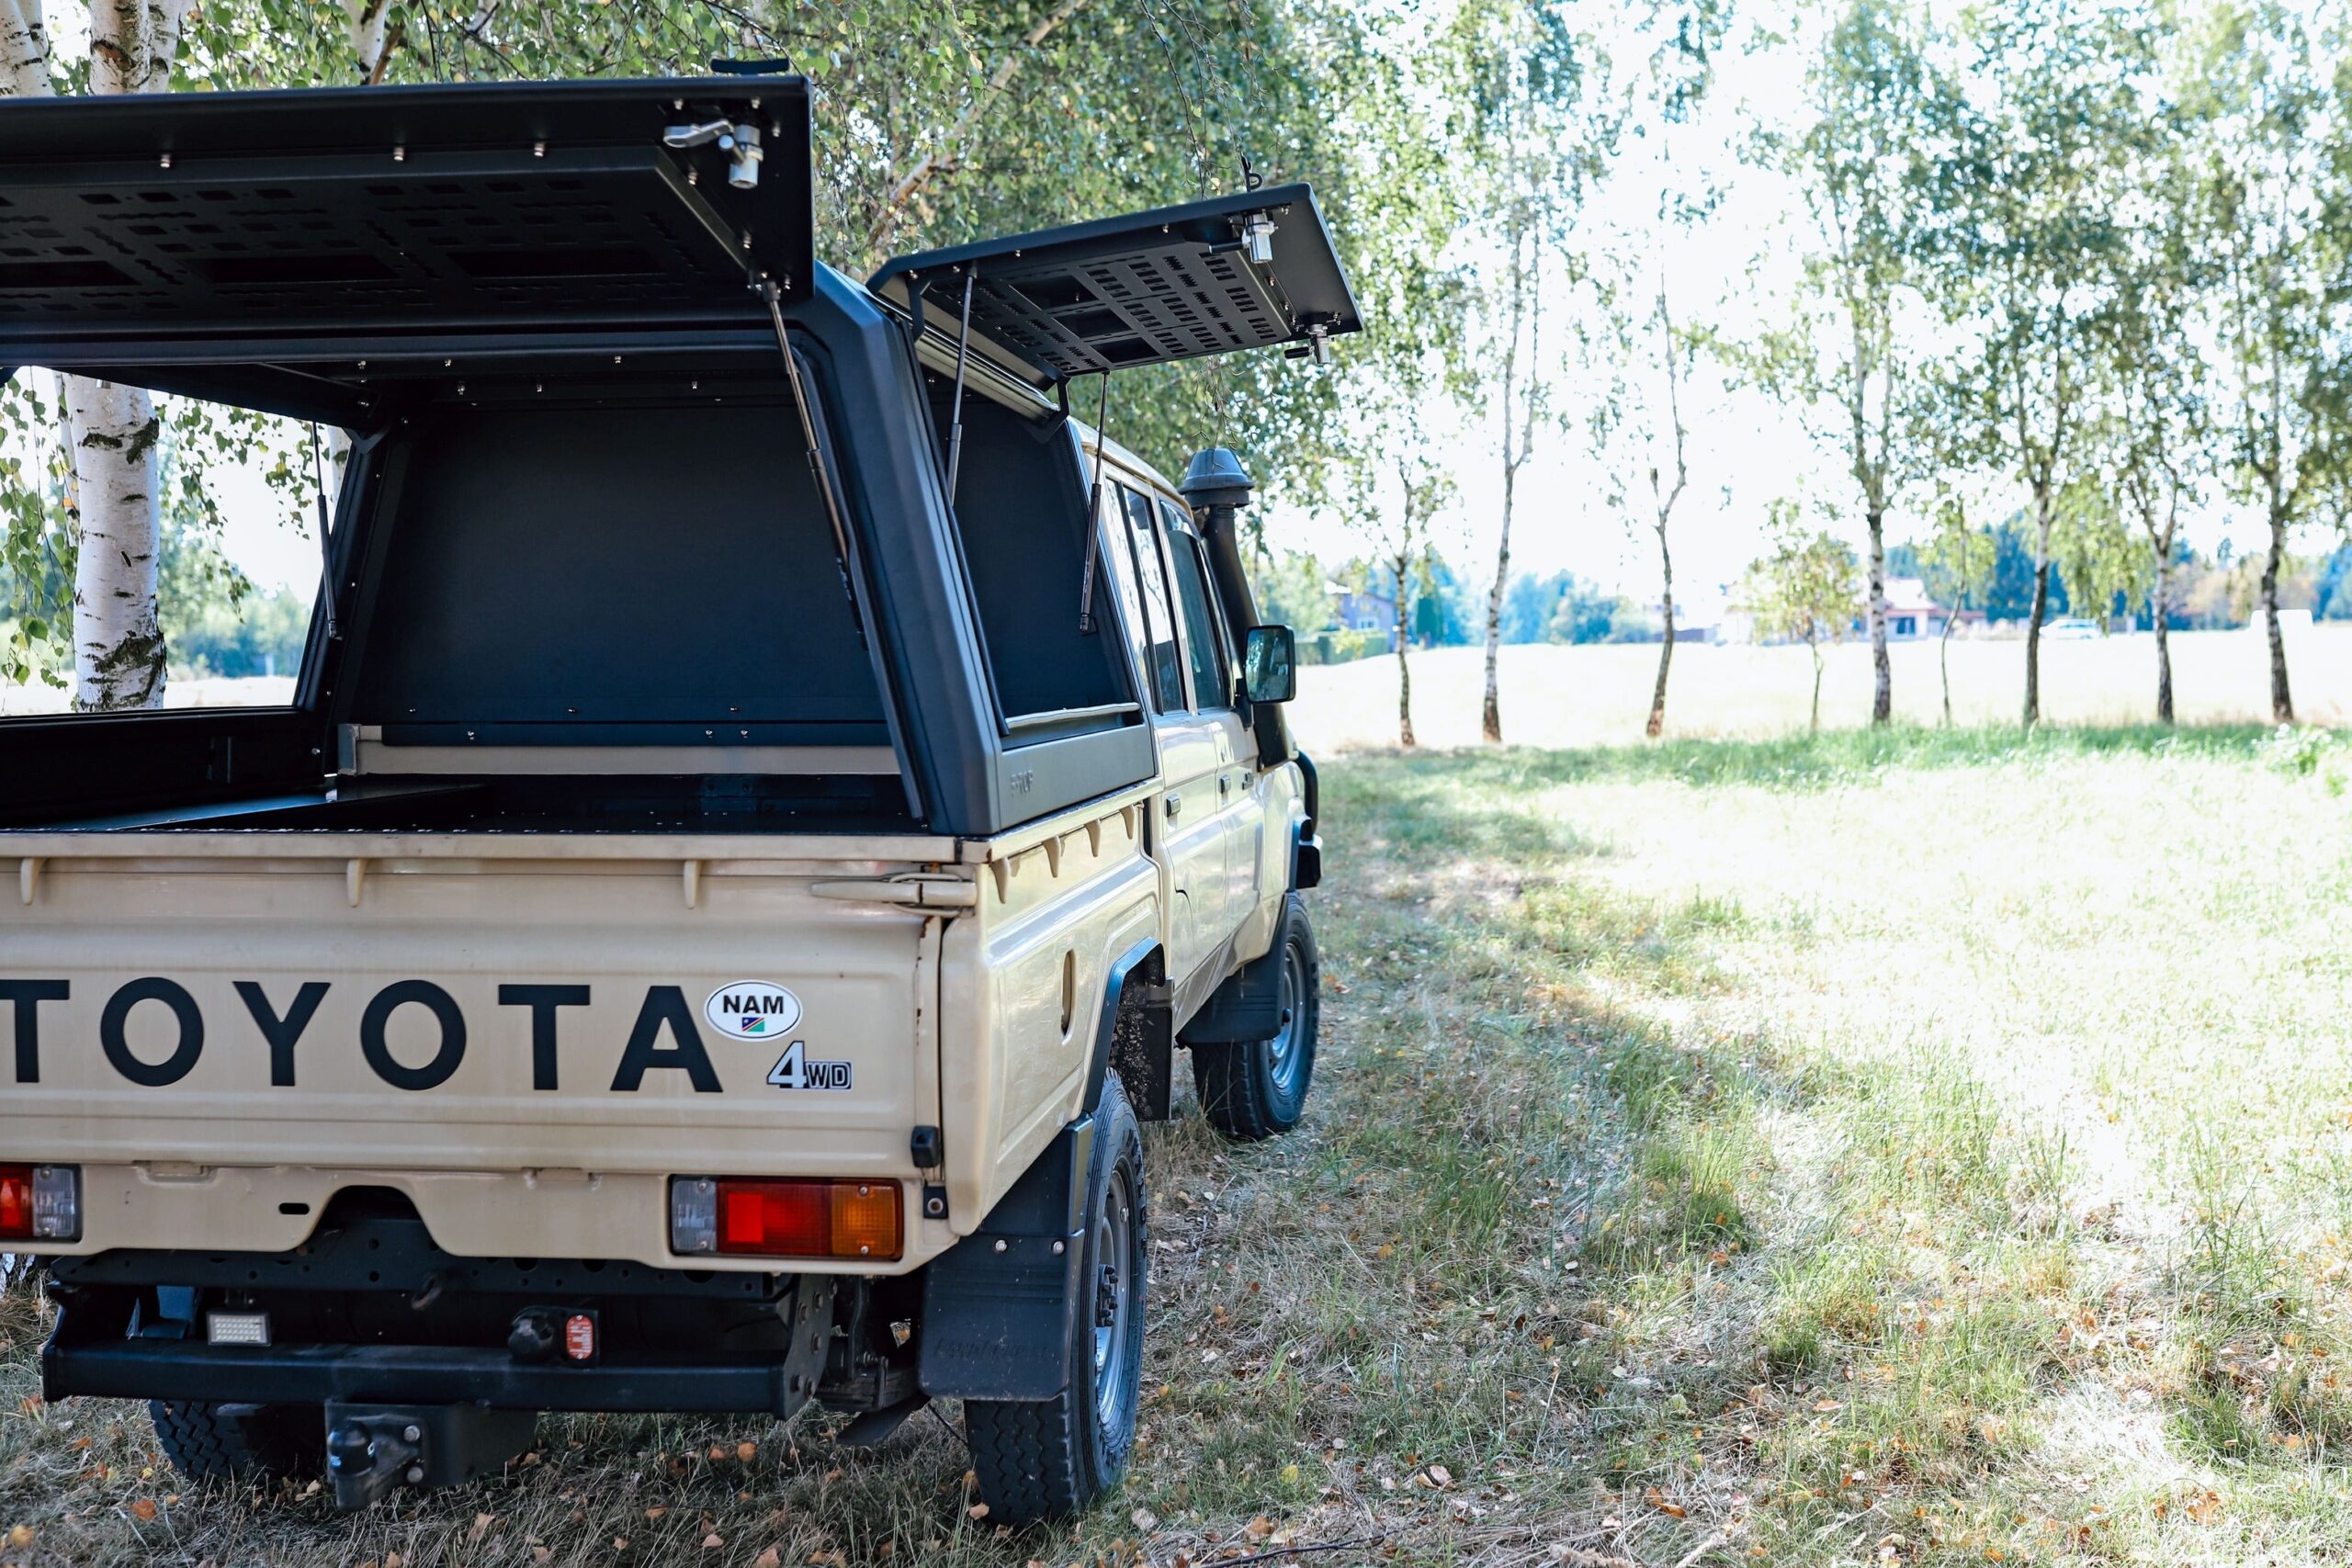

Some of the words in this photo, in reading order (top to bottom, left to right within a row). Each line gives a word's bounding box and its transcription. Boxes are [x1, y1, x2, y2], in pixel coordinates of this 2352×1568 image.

[723, 995, 785, 1014] NAM
[0, 976, 723, 1092] TOYOTA
[766, 1041, 853, 1089] 4WD
